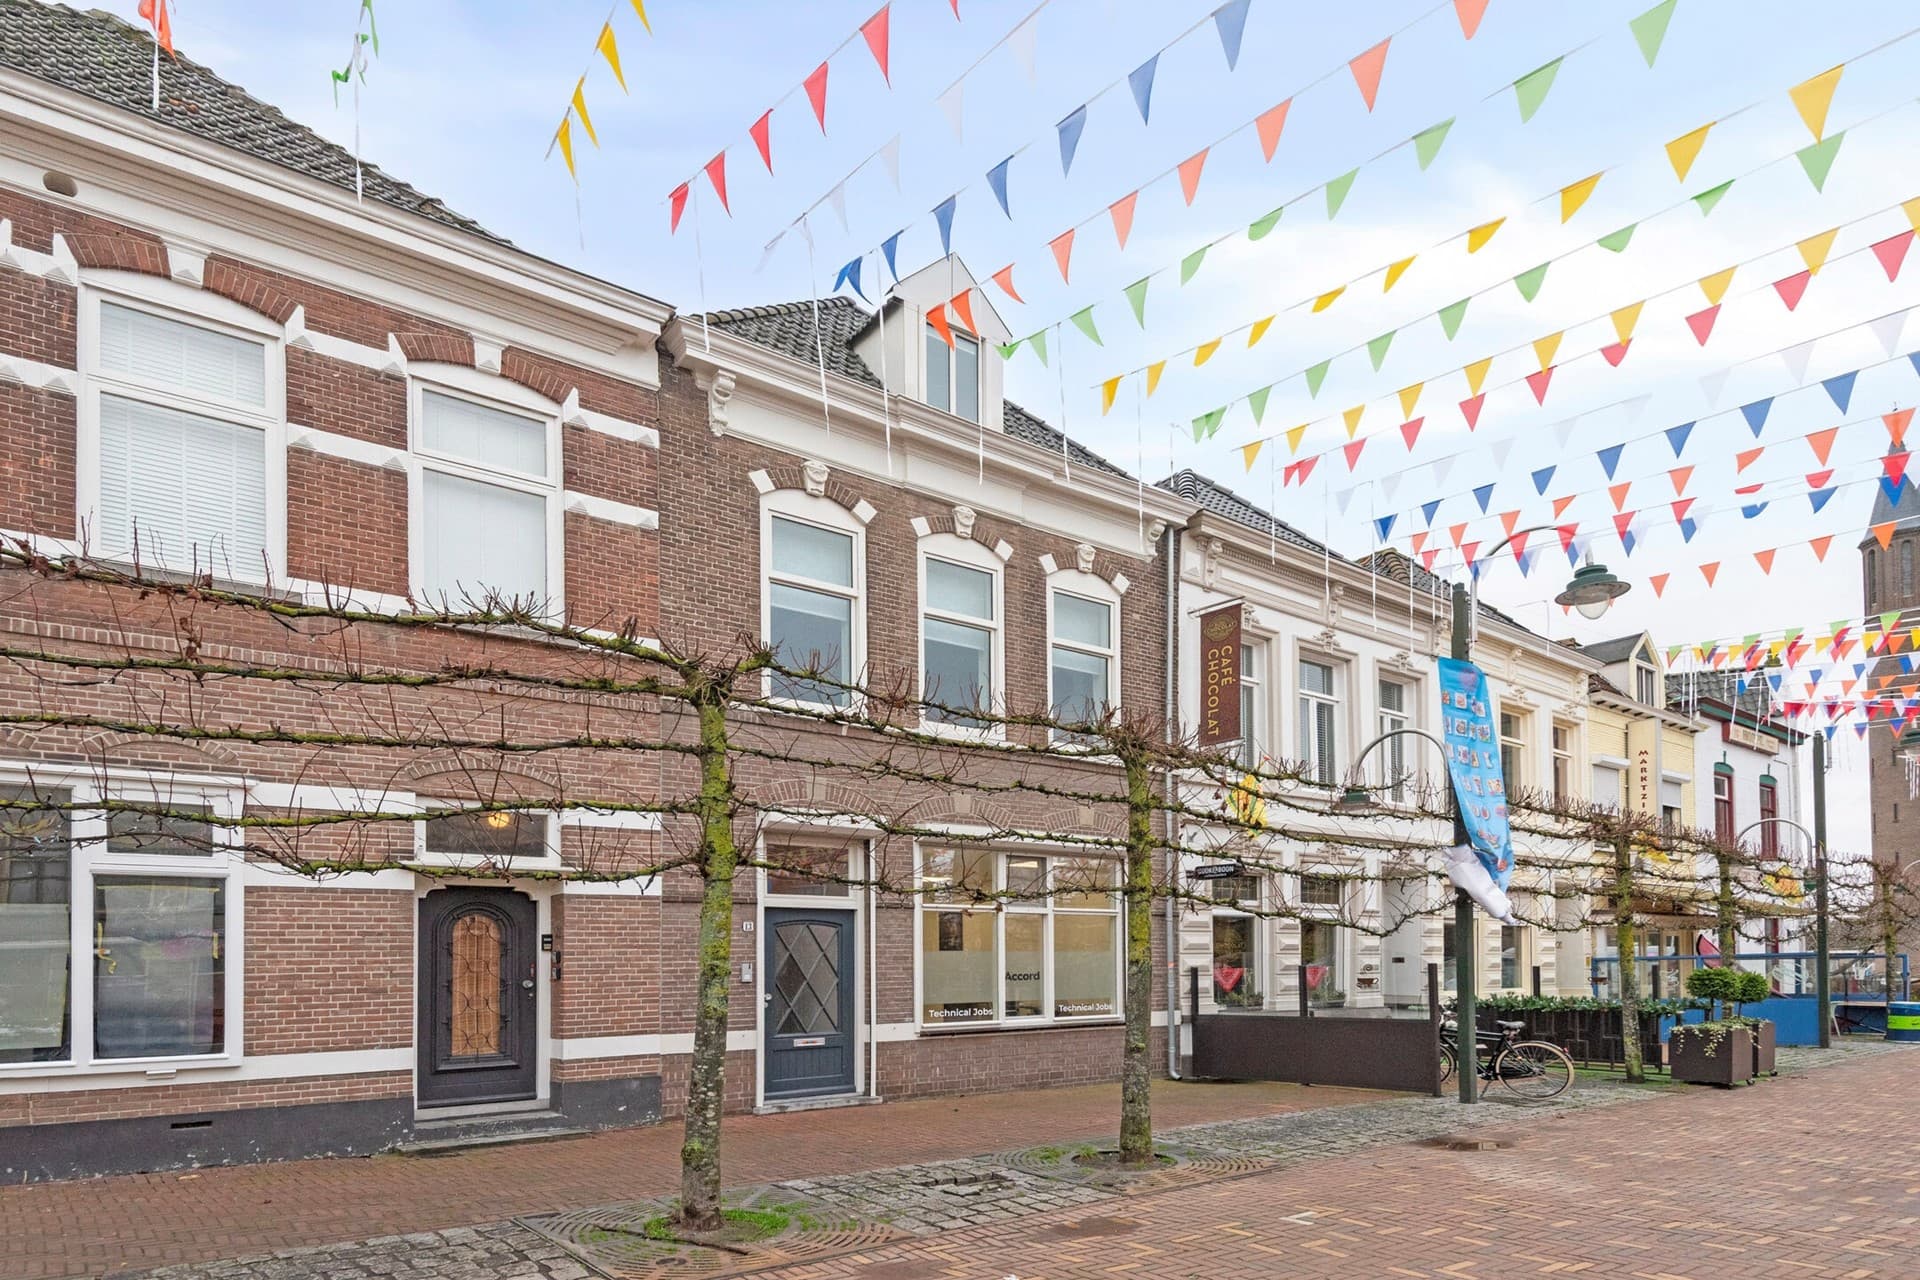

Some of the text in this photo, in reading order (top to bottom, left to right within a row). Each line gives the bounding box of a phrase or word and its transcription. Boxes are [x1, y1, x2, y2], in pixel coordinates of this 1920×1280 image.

[1221, 645, 1236, 687] CAFÉ
[1207, 648, 1220, 736] CHOCOLAT
[1005, 971, 1040, 981] Accord
[928, 1008, 993, 1017] Technical Jobs
[1058, 1003, 1112, 1012] Technical Jobs
